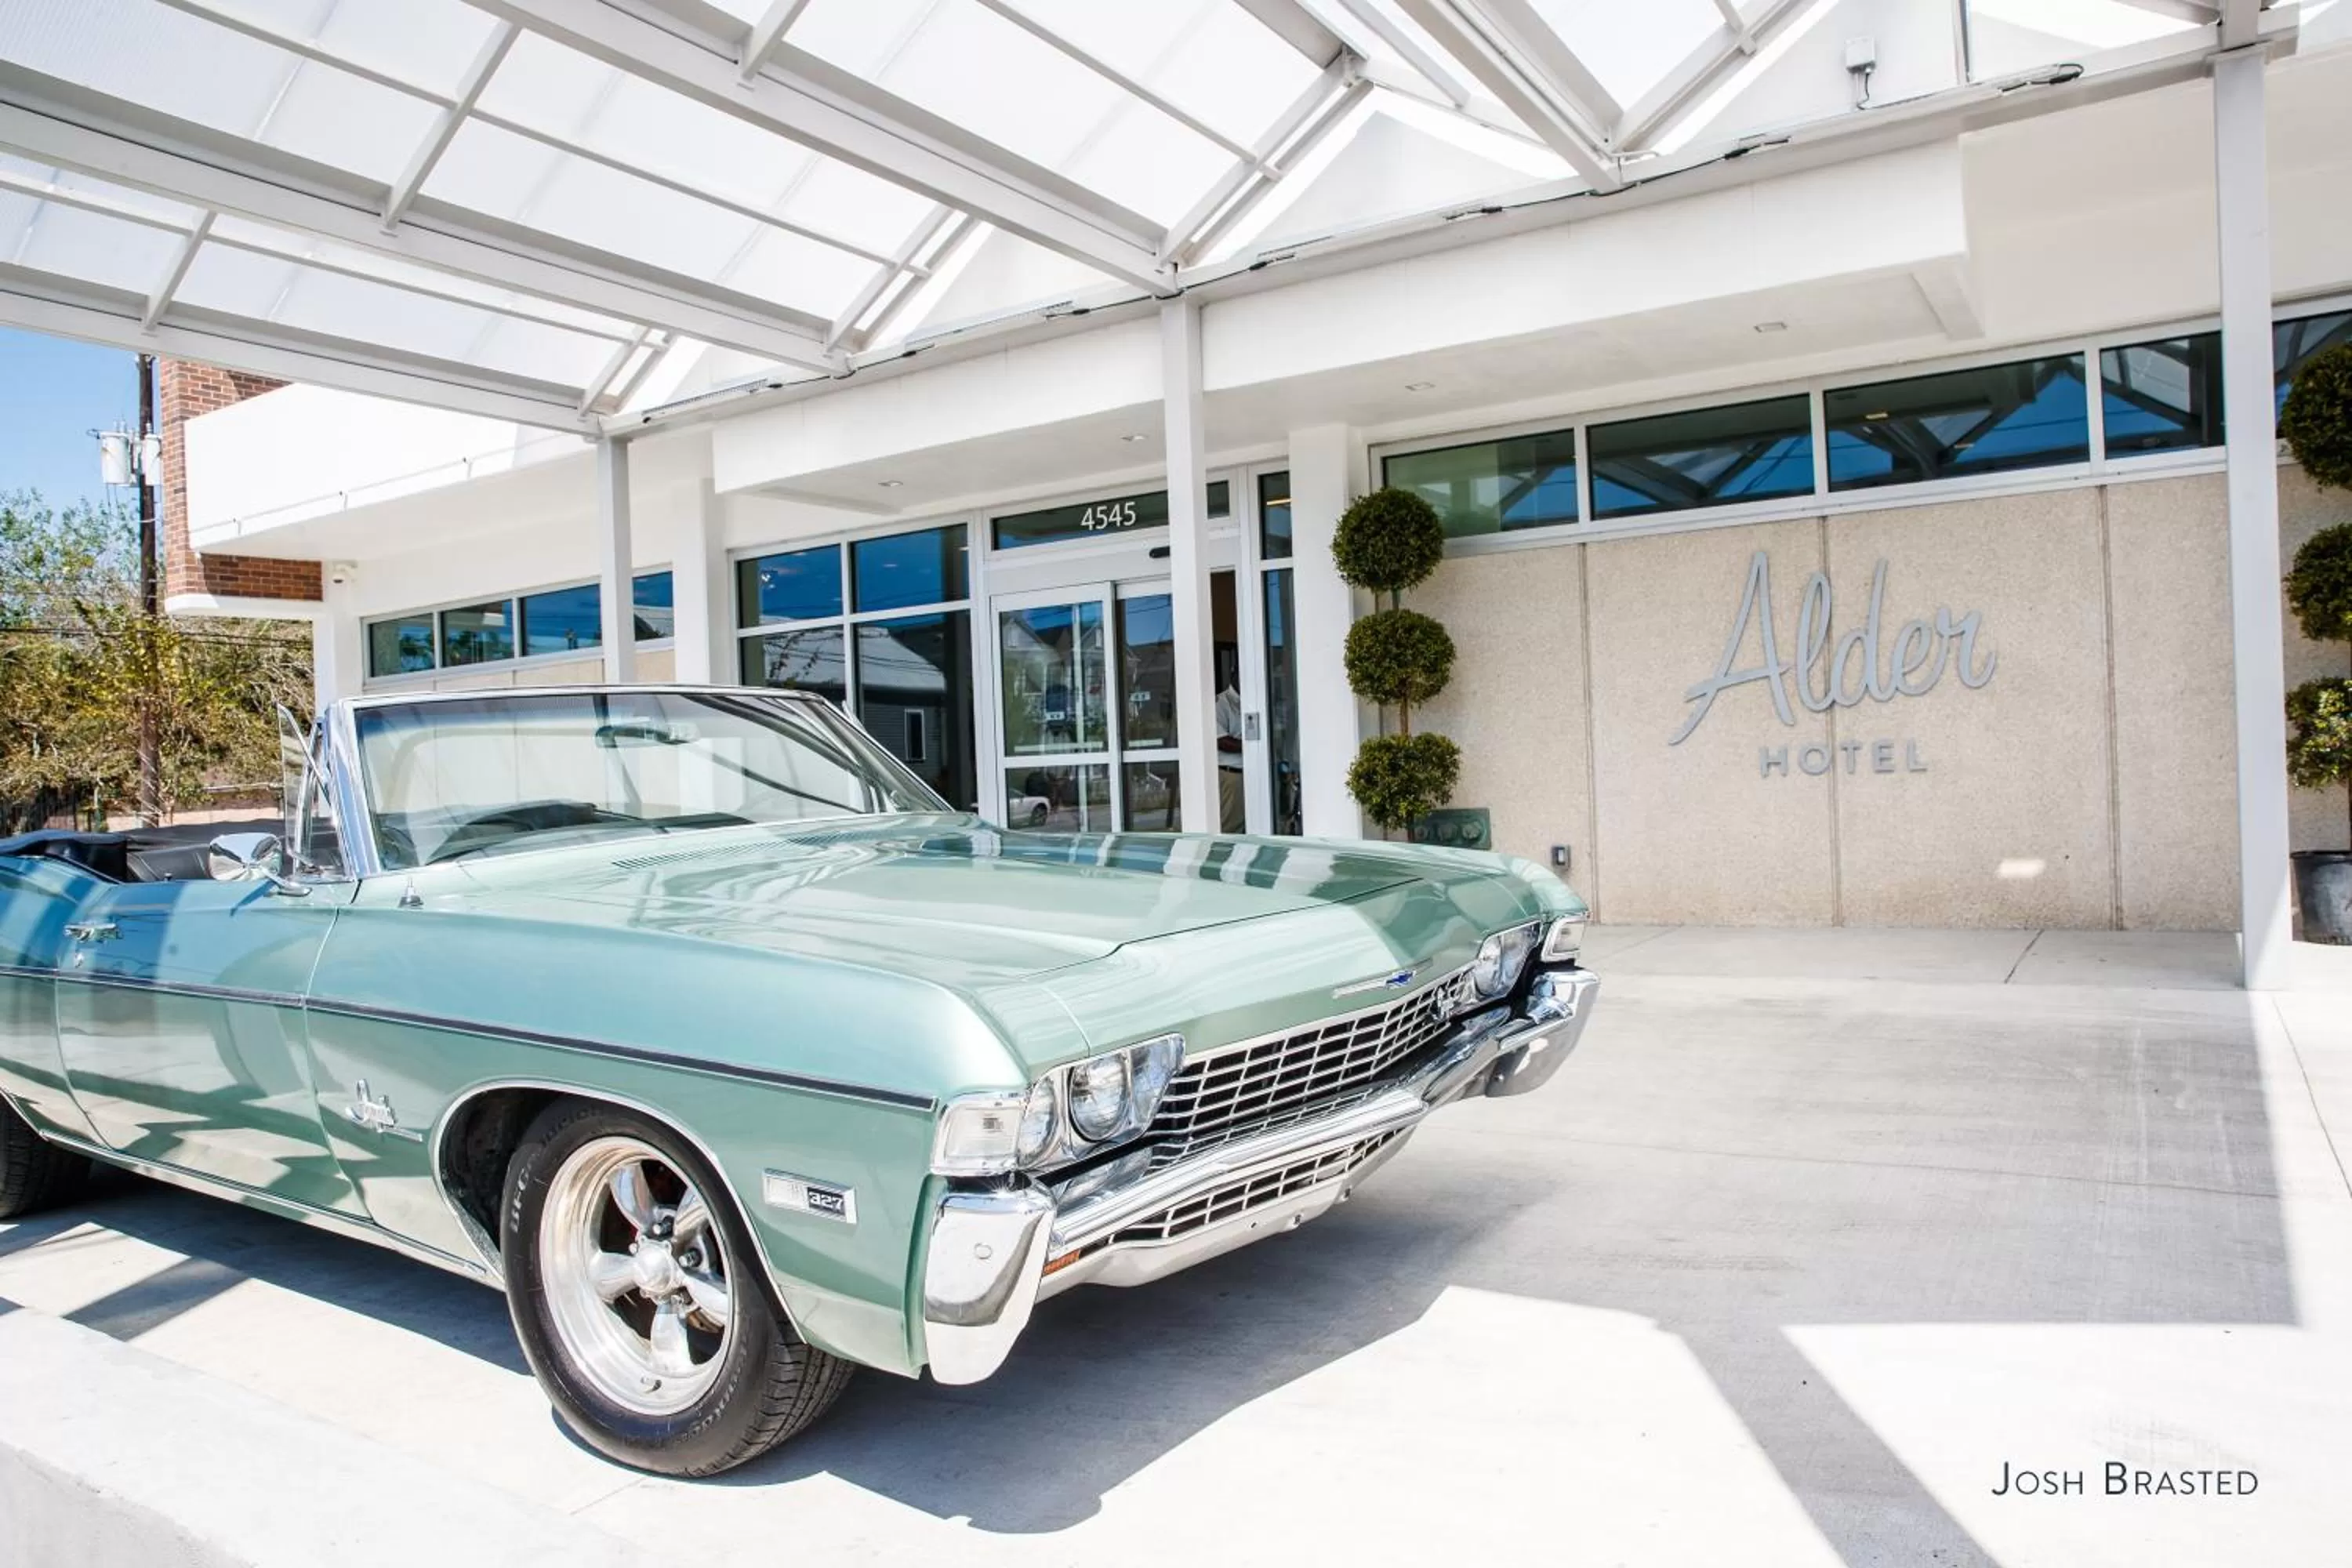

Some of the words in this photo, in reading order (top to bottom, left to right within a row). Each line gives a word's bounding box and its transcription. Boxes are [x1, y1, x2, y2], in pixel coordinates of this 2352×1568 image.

[1080, 501, 1136, 531] 4545
[1668, 550, 1996, 746] Alder
[1759, 739, 1929, 779] HOTEL
[808, 1191, 844, 1210] 327
